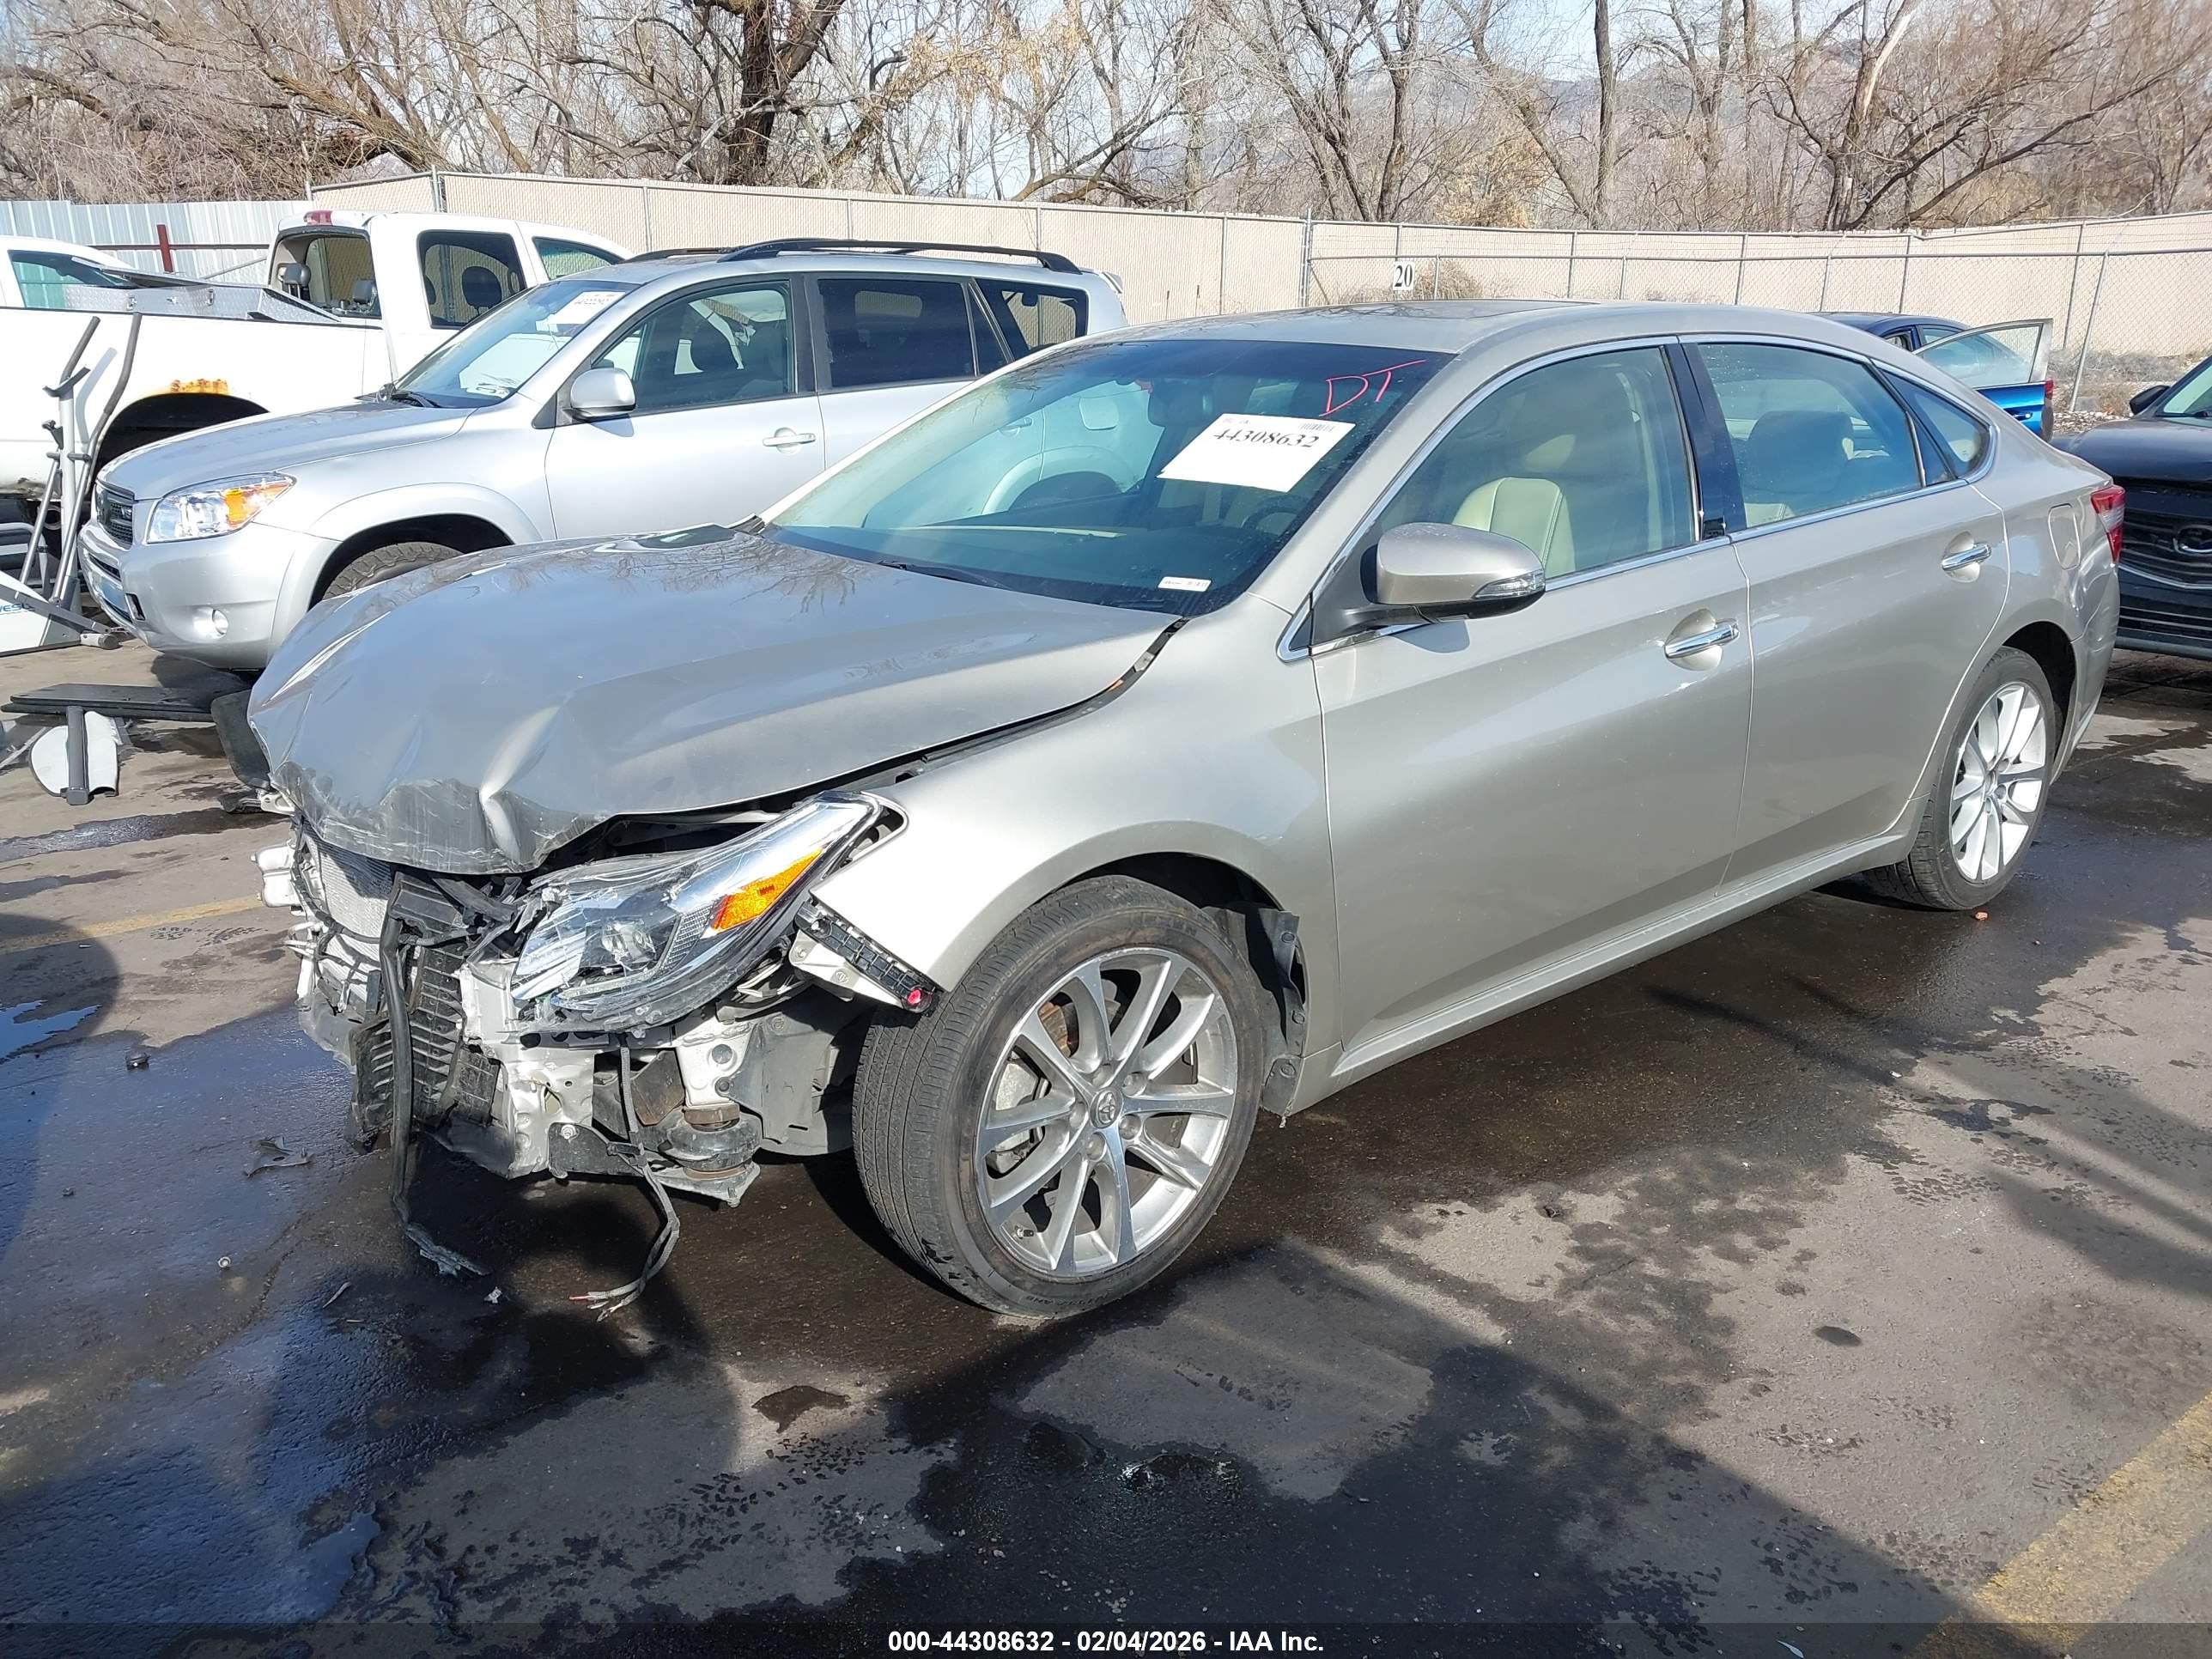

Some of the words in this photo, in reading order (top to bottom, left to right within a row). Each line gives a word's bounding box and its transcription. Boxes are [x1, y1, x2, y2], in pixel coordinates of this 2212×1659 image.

[1394, 264, 1413, 288] 20
[1319, 359, 1427, 416] DT
[1212, 428, 1320, 447] 44308632
